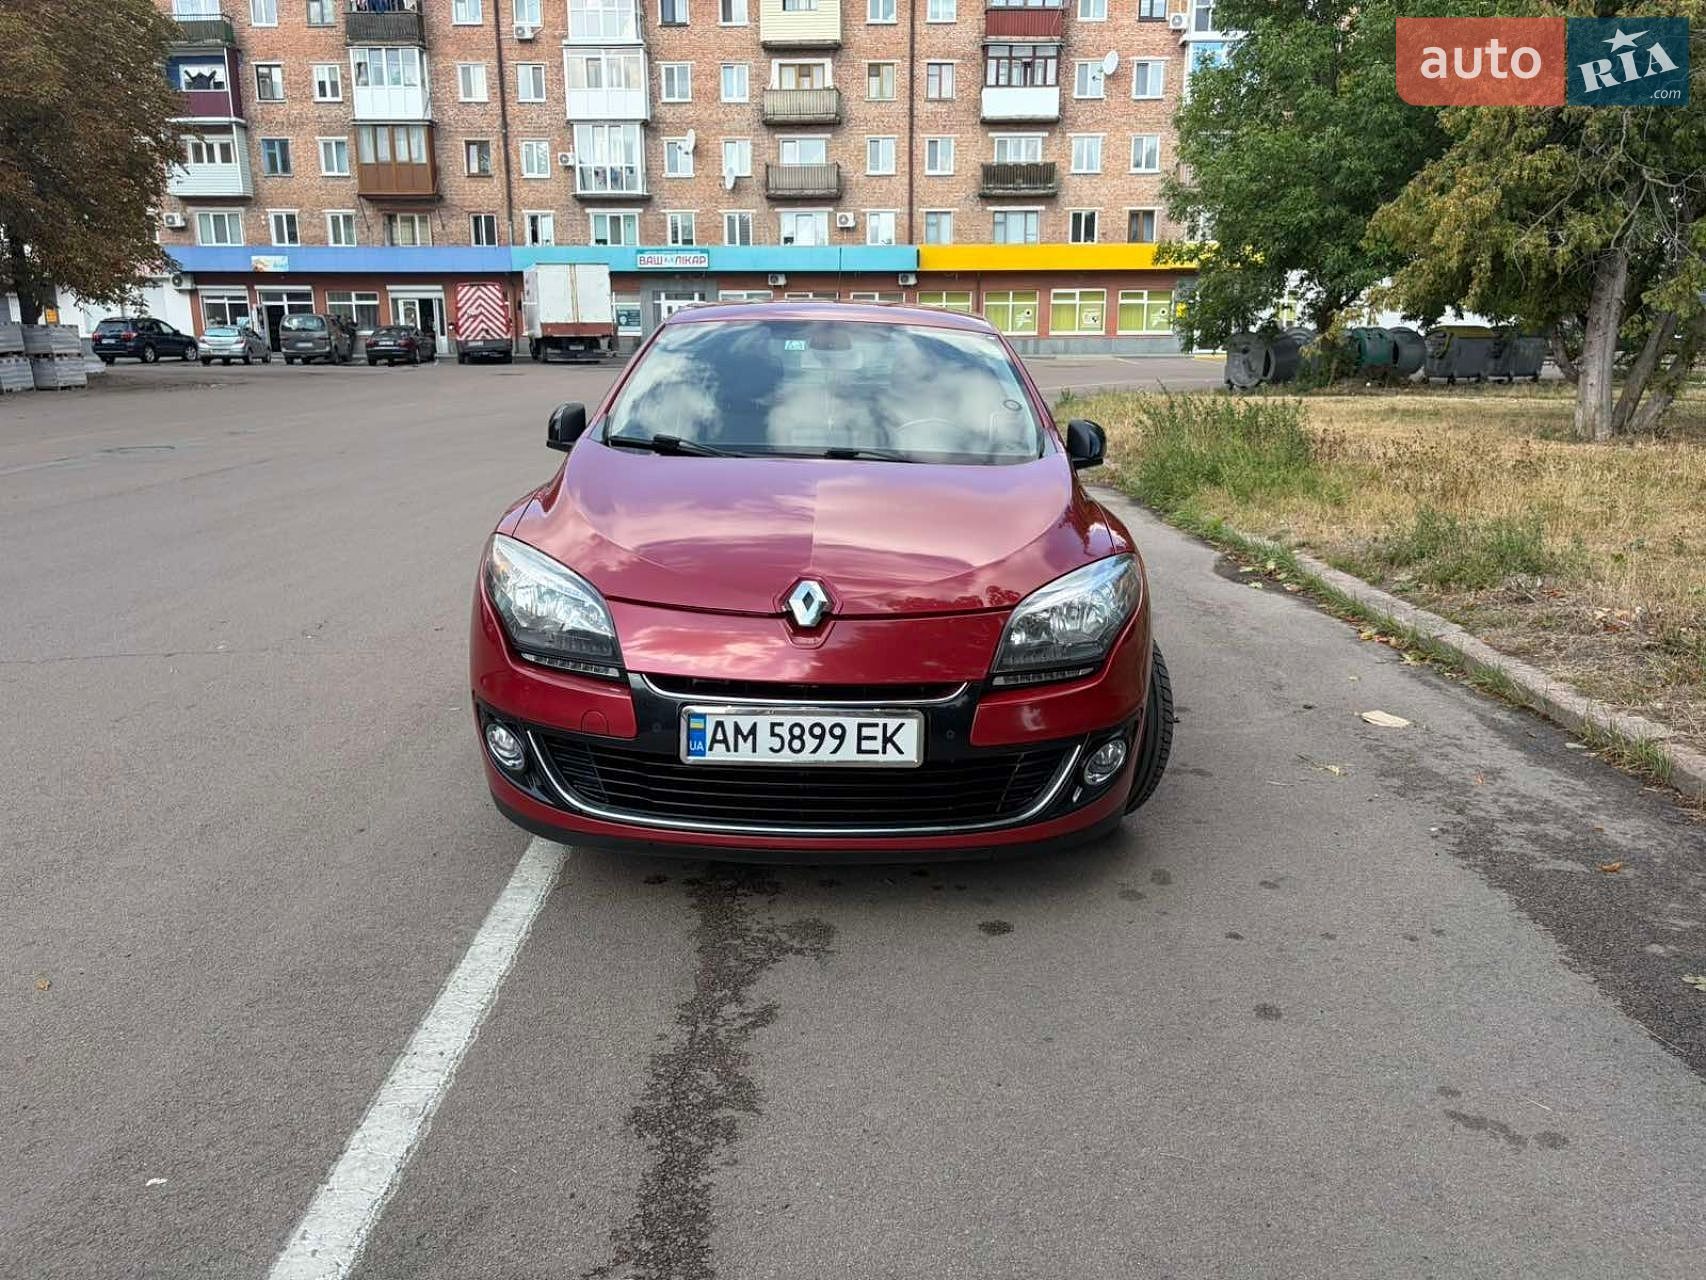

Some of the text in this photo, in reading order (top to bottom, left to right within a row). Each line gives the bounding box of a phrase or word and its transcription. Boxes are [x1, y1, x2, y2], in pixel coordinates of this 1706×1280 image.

[639, 255, 707, 266] ВАШ ЛІКАР
[708, 719, 906, 756] AM 5899 EK
[689, 740, 705, 752] UA
